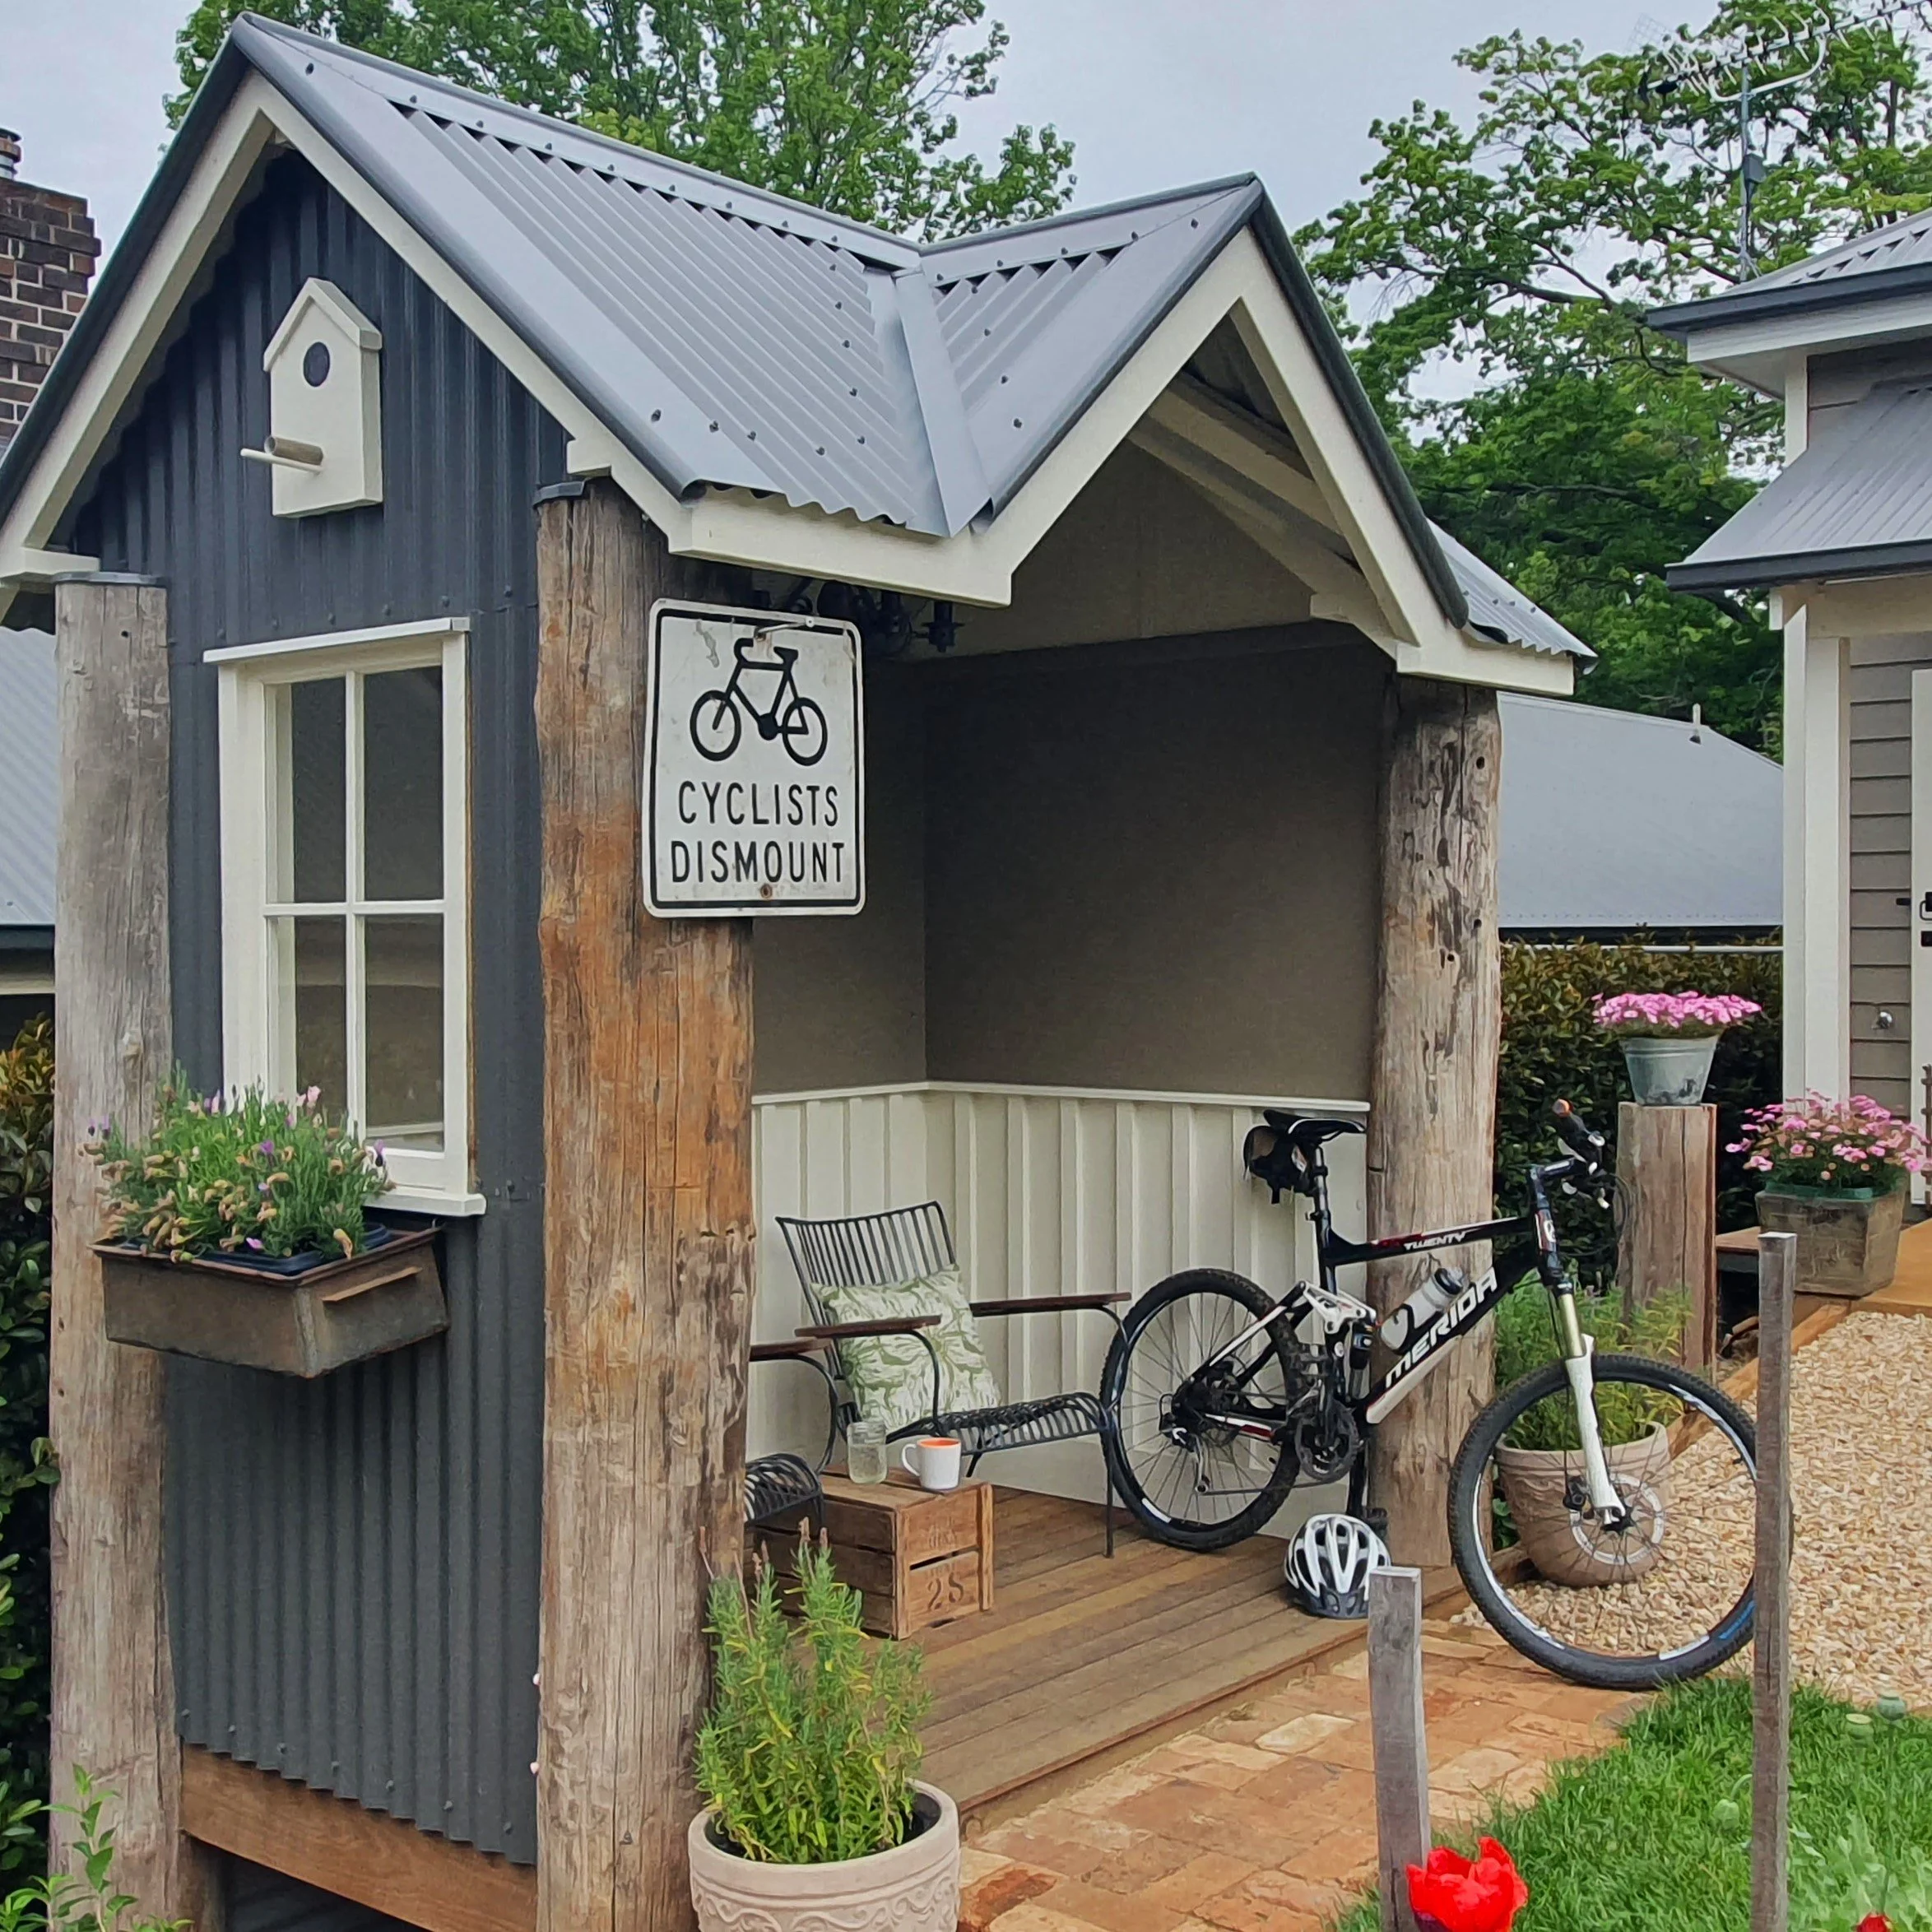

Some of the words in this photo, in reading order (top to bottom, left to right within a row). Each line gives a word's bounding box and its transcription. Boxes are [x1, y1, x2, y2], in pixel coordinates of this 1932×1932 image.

[679, 781, 838, 826] CYCLISTS
[671, 840, 844, 882] DISMOUNT
[1404, 1232, 1465, 1251] TWENTY
[1386, 1266, 1498, 1388] MERIDA
